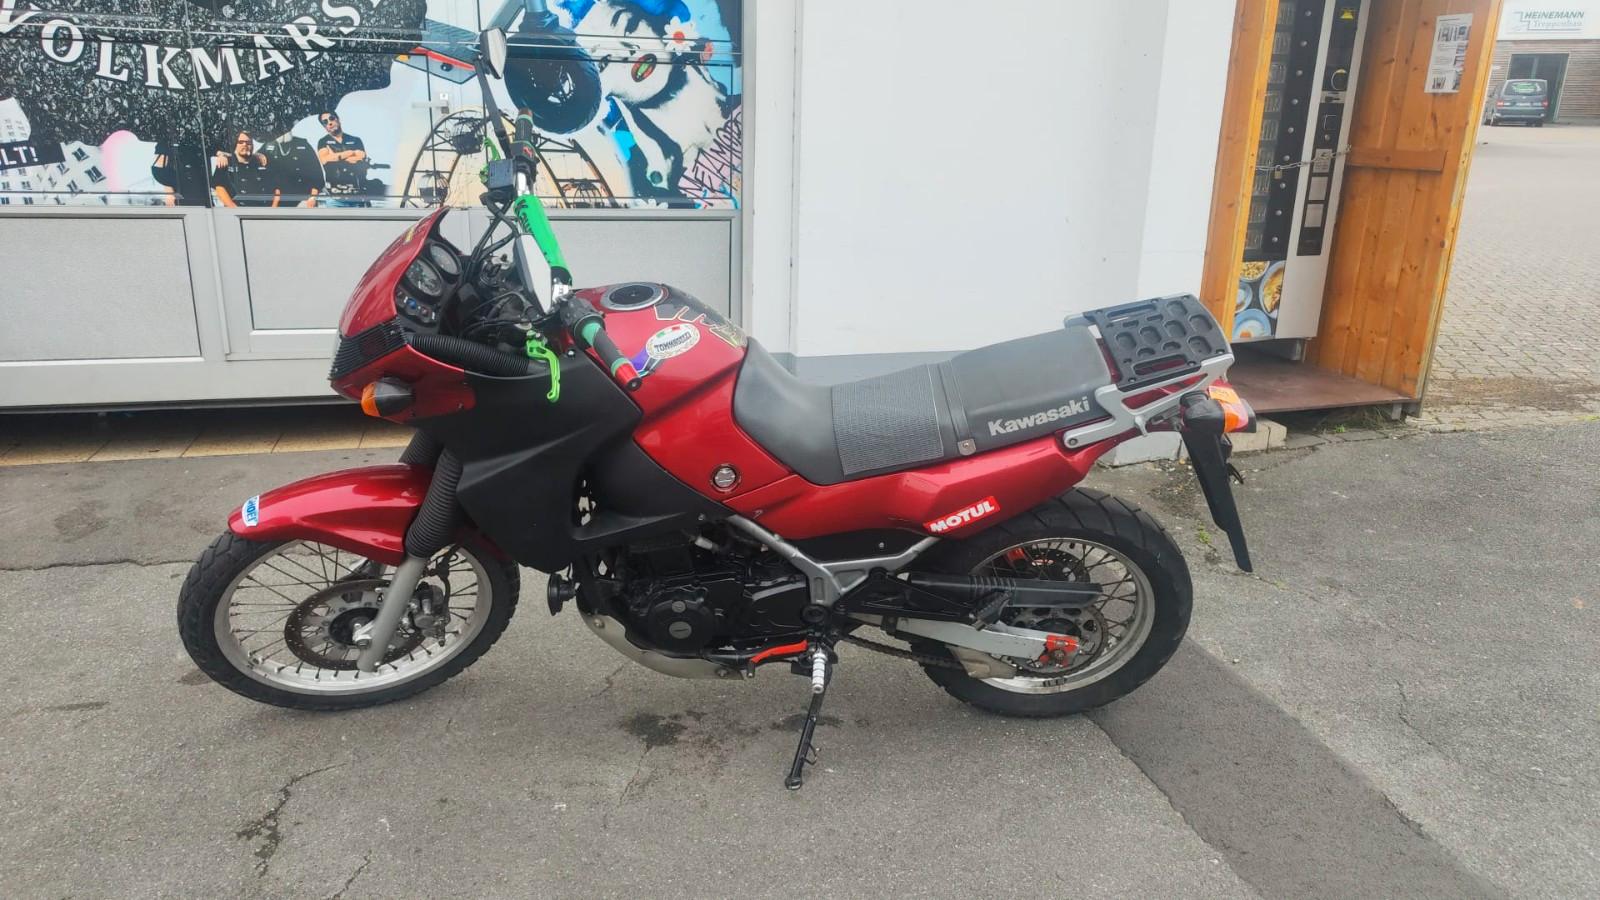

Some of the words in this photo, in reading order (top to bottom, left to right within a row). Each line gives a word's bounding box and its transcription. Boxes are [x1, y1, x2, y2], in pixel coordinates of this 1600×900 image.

[1524, 11, 1585, 19] HEINEMANN
[0, 0, 379, 90] VOLKMARS
[0, 146, 38, 165] LT!
[988, 396, 1090, 436] Kawasaki
[929, 501, 995, 533] MOTUL
